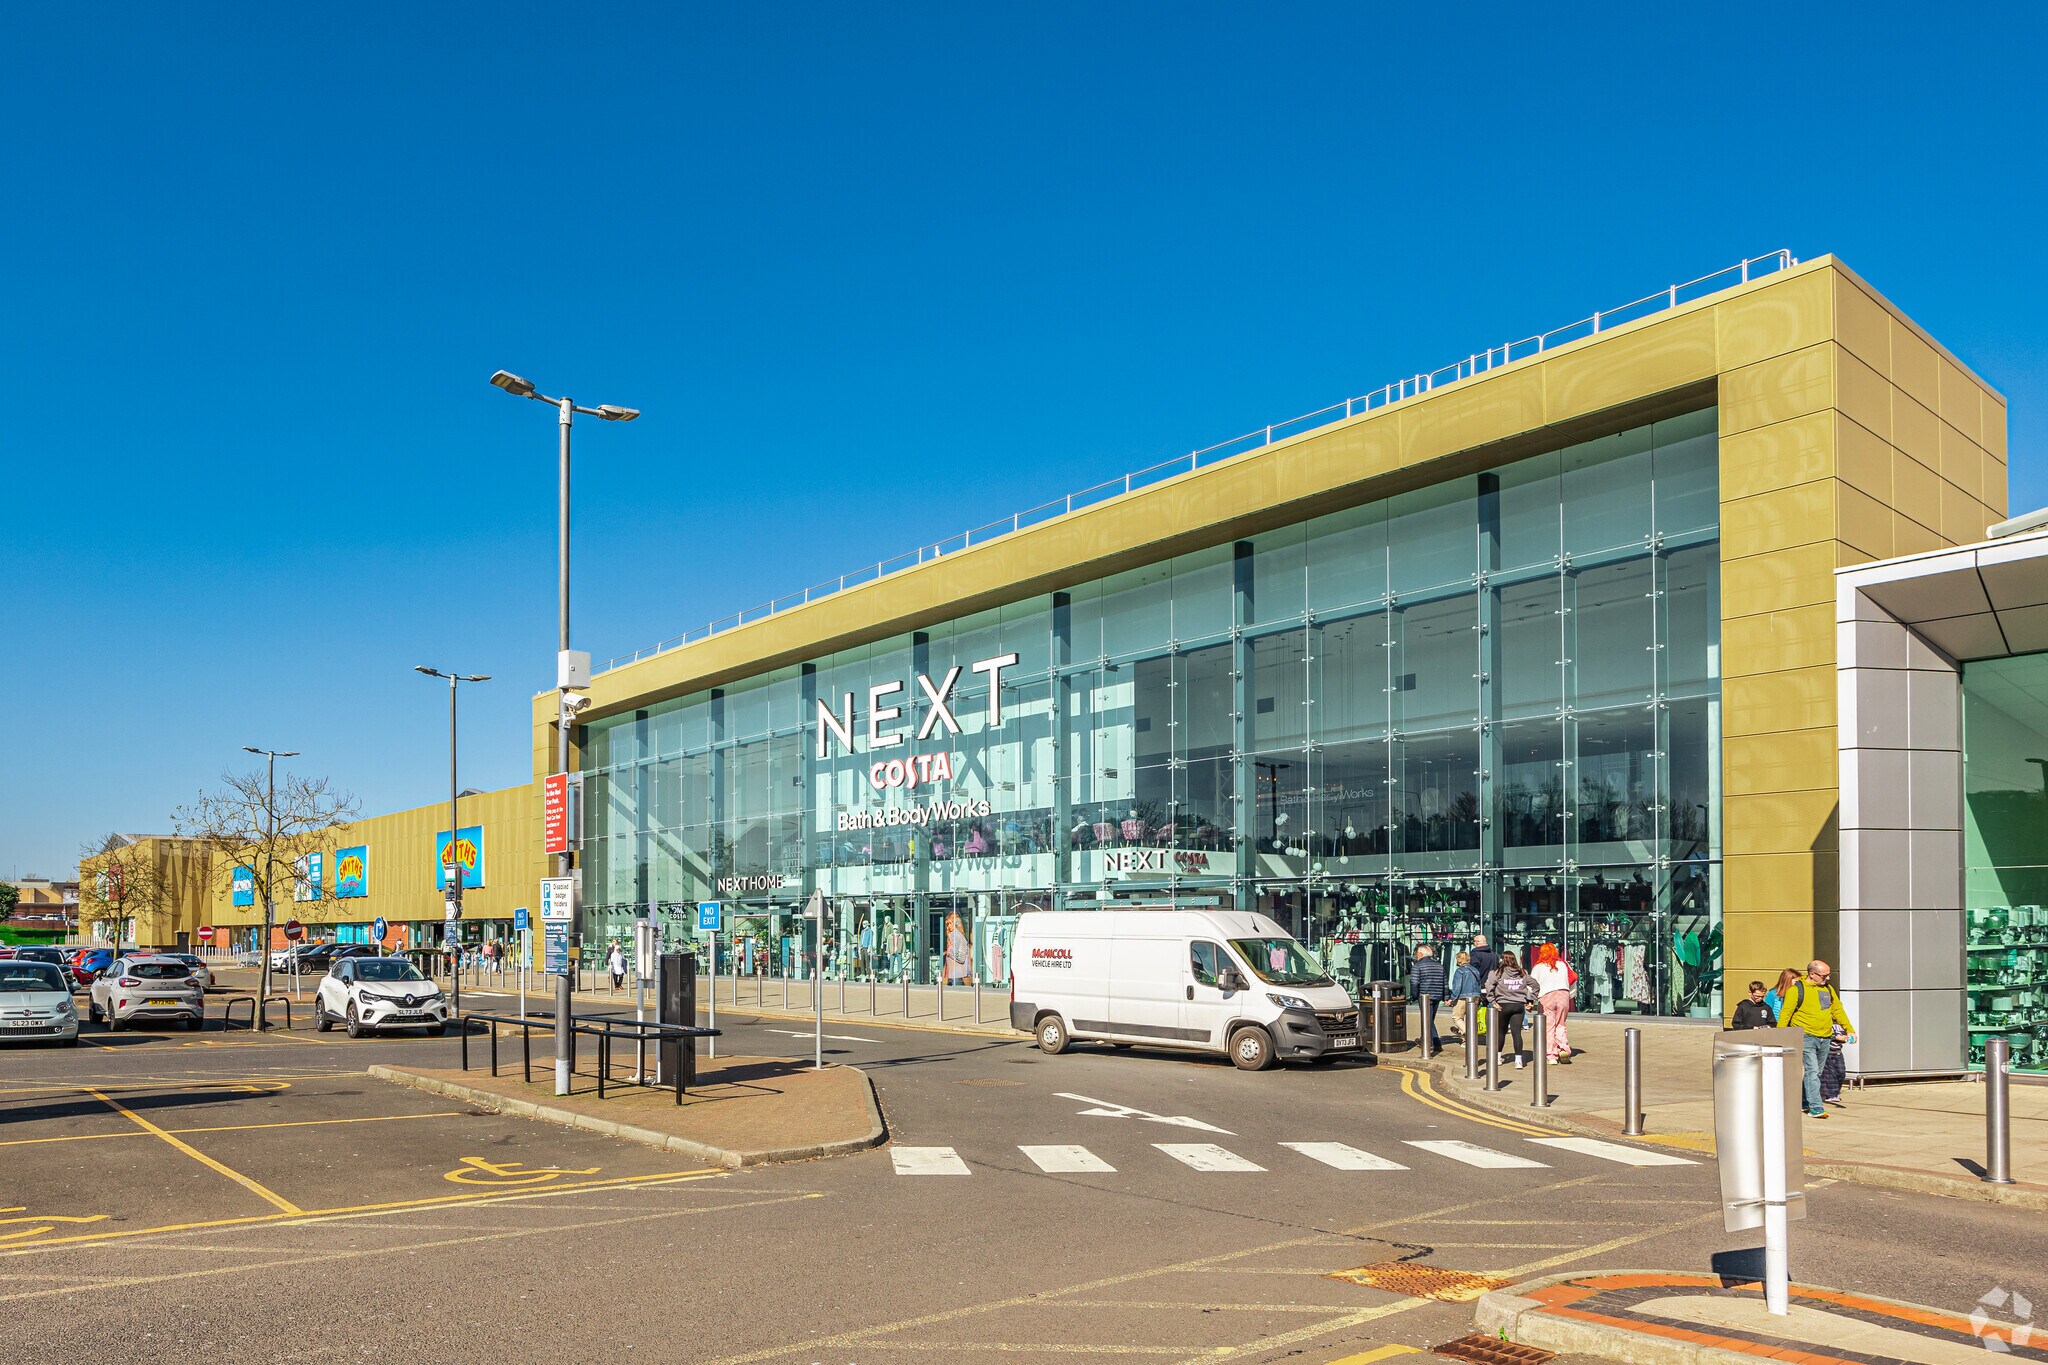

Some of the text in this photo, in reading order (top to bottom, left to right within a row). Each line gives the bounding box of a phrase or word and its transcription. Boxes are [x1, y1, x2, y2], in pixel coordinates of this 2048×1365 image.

[818, 653, 1018, 758] NEXT
[870, 752, 953, 789] COSTA
[1340, 788, 1374, 800] Works
[838, 798, 991, 831] Bath & Body Works
[441, 842, 476, 869] SMTHS
[1104, 850, 1169, 871] NEXT
[1174, 851, 1207, 865] COSTA
[340, 857, 363, 881] SMYTHS
[718, 875, 783, 891] NEXT HOME
[555, 892, 566, 900] badge
[704, 907, 714, 915] NO
[703, 917, 716, 925] EXIT
[1032, 960, 1051, 968] VEHICLE
[1051, 960, 1062, 968] HIRE
